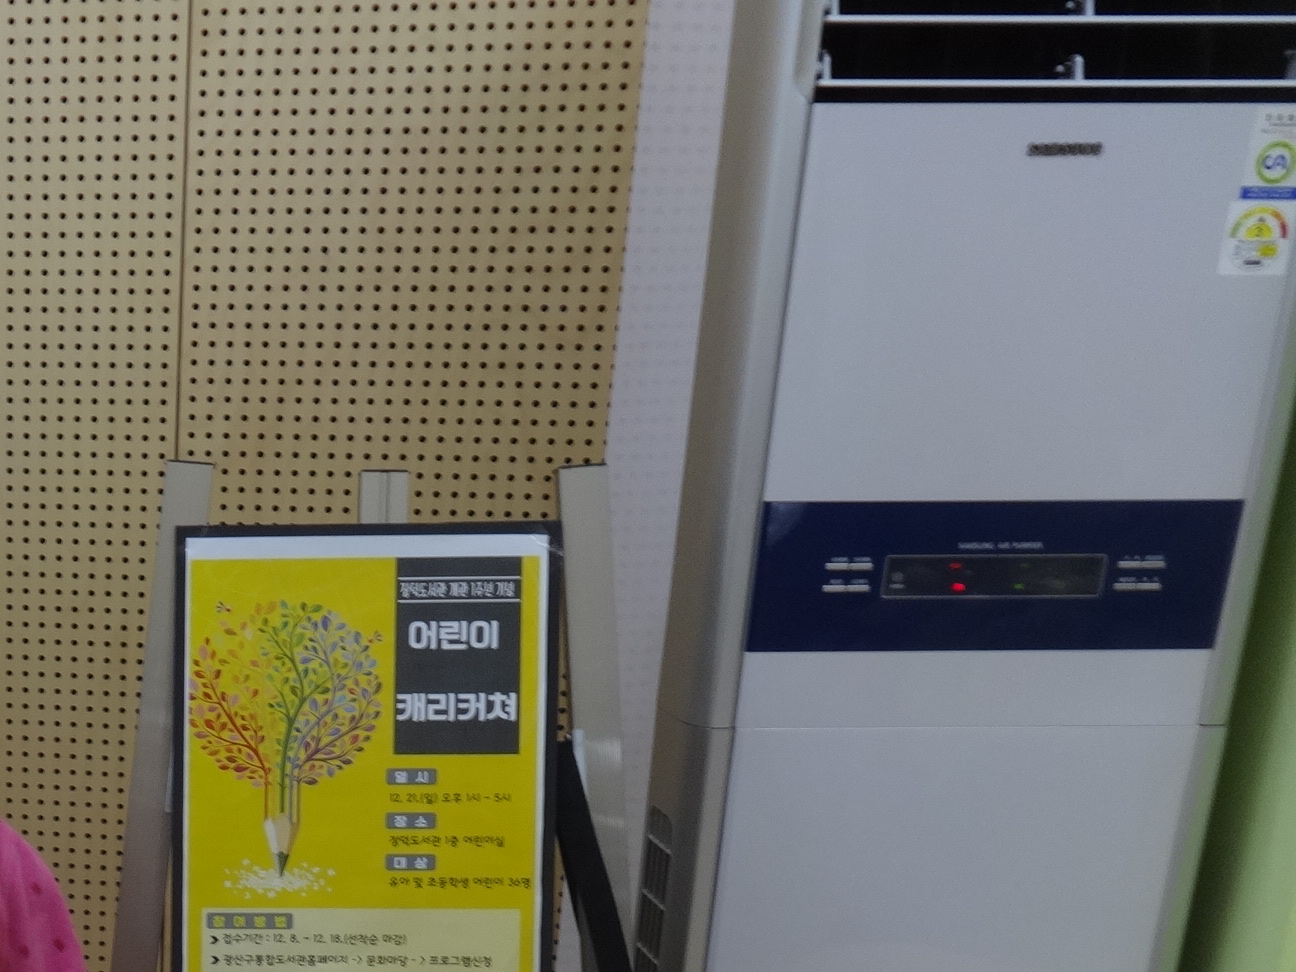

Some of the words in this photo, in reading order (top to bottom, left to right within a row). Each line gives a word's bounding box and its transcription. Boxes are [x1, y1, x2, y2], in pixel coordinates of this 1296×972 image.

[408, 620, 501, 650] 어린이
[396, 691, 518, 722] 캐리커쳐
[441, 792, 462, 804] 오후
[414, 815, 429, 828] 소
[463, 835, 504, 847] 어린이실
[389, 877, 410, 889] 유아
[413, 877, 424, 889] 및
[427, 877, 469, 889] 초등학생
[472, 877, 503, 889] 어린이
[508, 877, 531, 889] 36명
[223, 933, 263, 945] 접수기간
[366, 955, 409, 967] 문화마당
[429, 955, 493, 968] 프로그램신청
